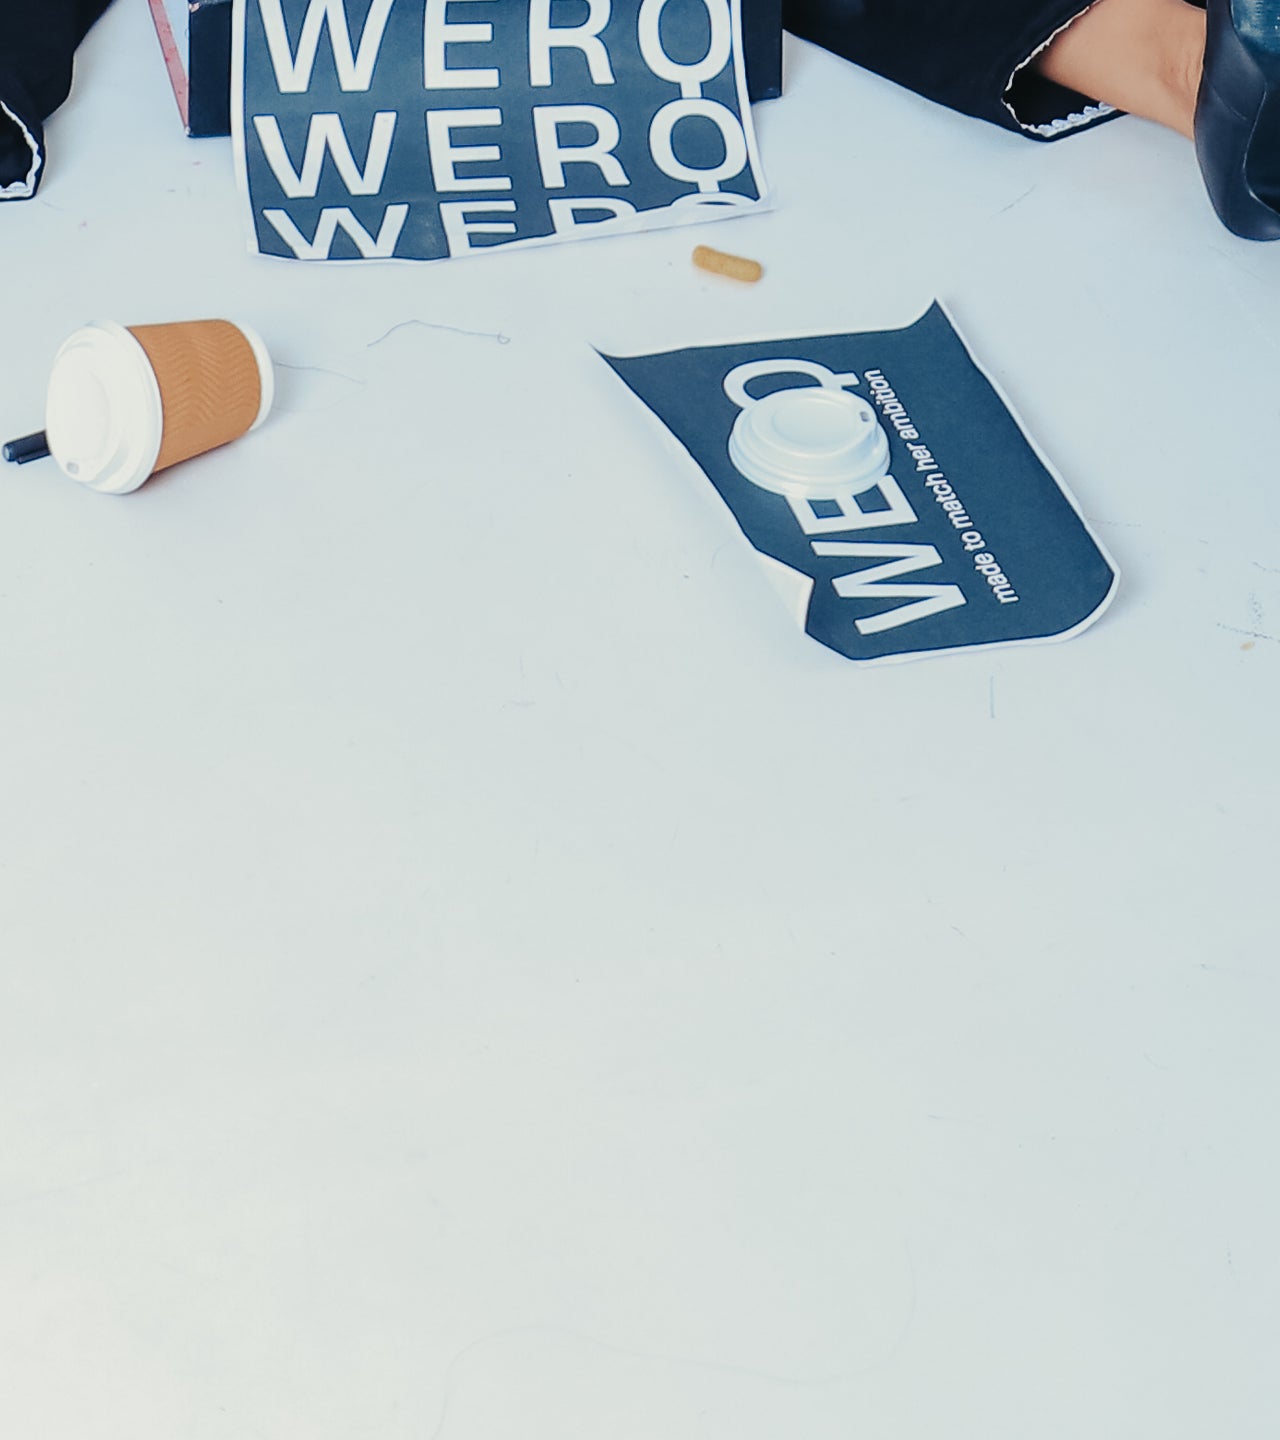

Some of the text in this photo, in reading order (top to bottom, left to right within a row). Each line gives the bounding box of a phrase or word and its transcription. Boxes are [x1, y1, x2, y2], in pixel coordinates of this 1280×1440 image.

[253, 97, 749, 198] WERQ
[263, 192, 760, 258] WE
[723, 358, 968, 635] WEQ
[863, 368, 1019, 604] made to match her ambition
